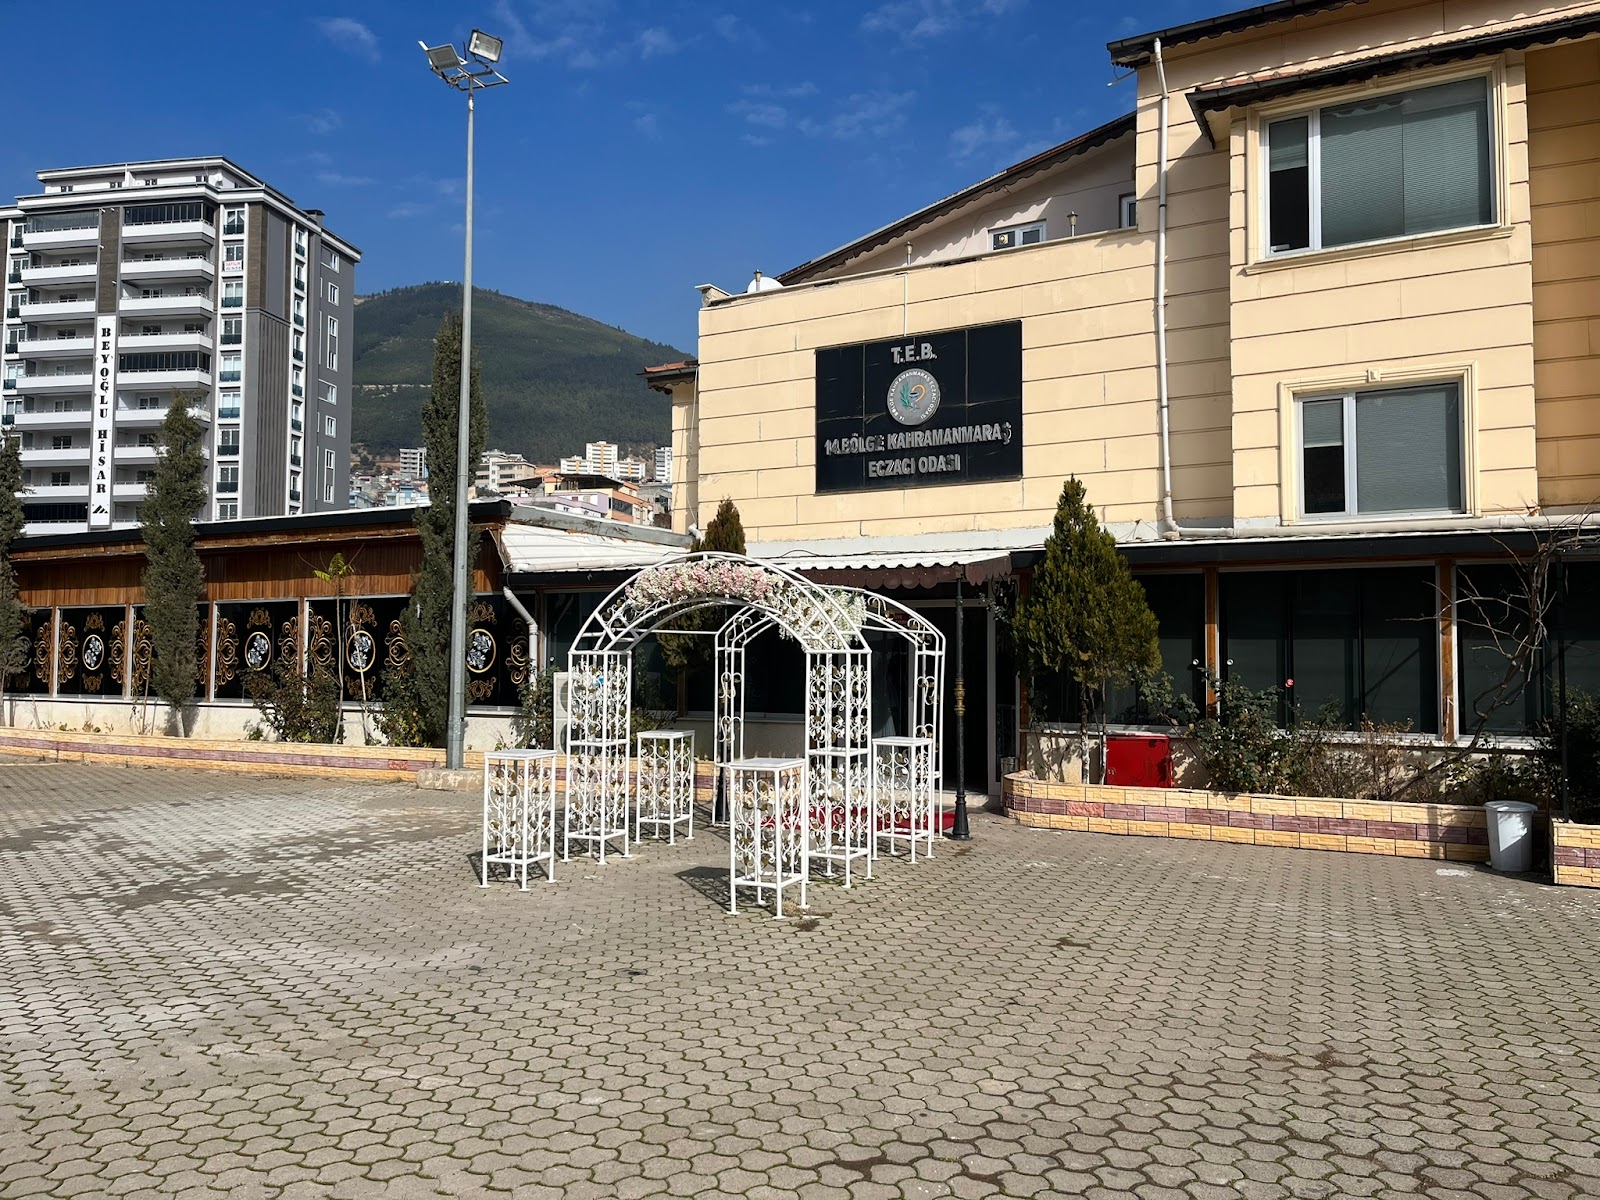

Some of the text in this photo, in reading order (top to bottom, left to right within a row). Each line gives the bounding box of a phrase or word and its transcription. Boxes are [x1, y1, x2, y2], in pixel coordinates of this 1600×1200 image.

[890, 342, 938, 364] T.E.B.
[96, 327, 112, 494] BEYOĞLU HİSAR
[887, 421, 1013, 450] KAHRAMANMARAŞ
[867, 453, 961, 478] ECZACI ODASI
